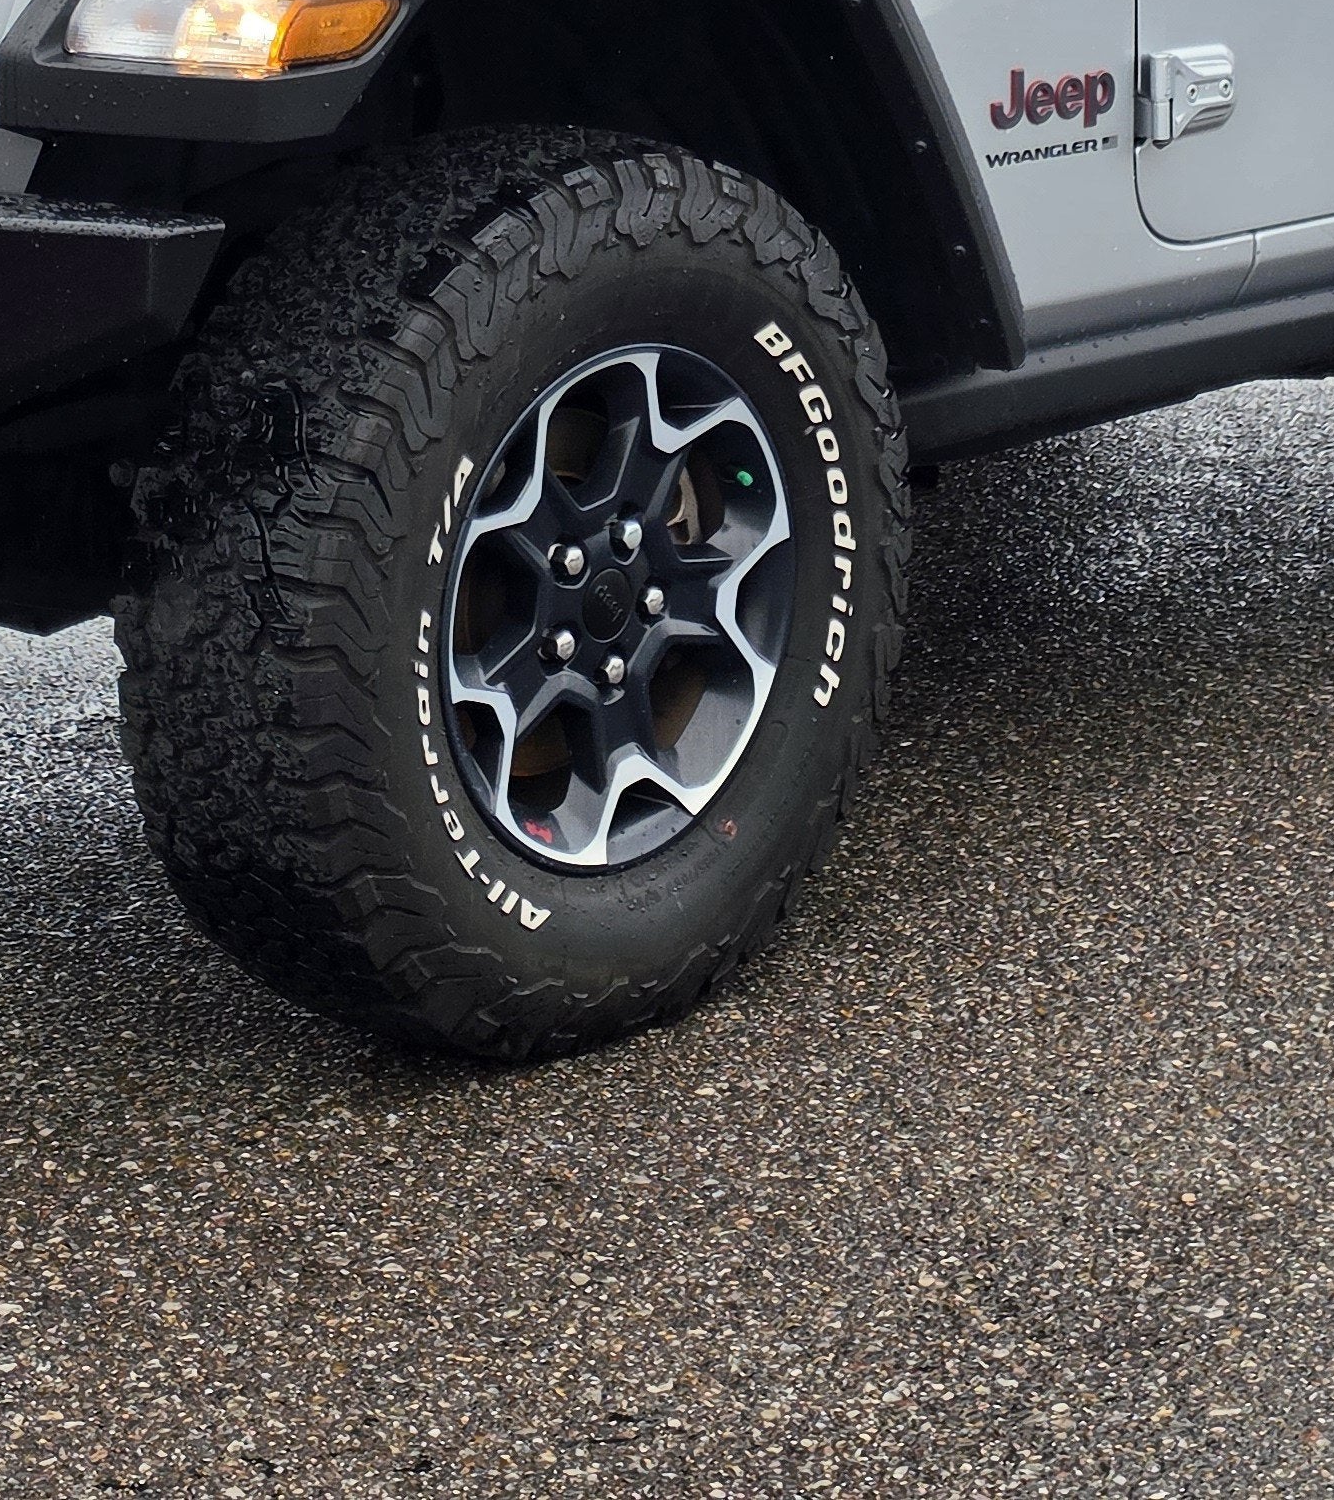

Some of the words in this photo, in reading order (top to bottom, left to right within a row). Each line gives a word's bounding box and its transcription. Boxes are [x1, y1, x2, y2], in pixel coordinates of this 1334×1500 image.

[985, 138, 1098, 169] WRANGLER
[990, 67, 1116, 130] Jeep
[753, 321, 857, 707] BFGoodrich
[414, 610, 552, 931] All-Terrain
